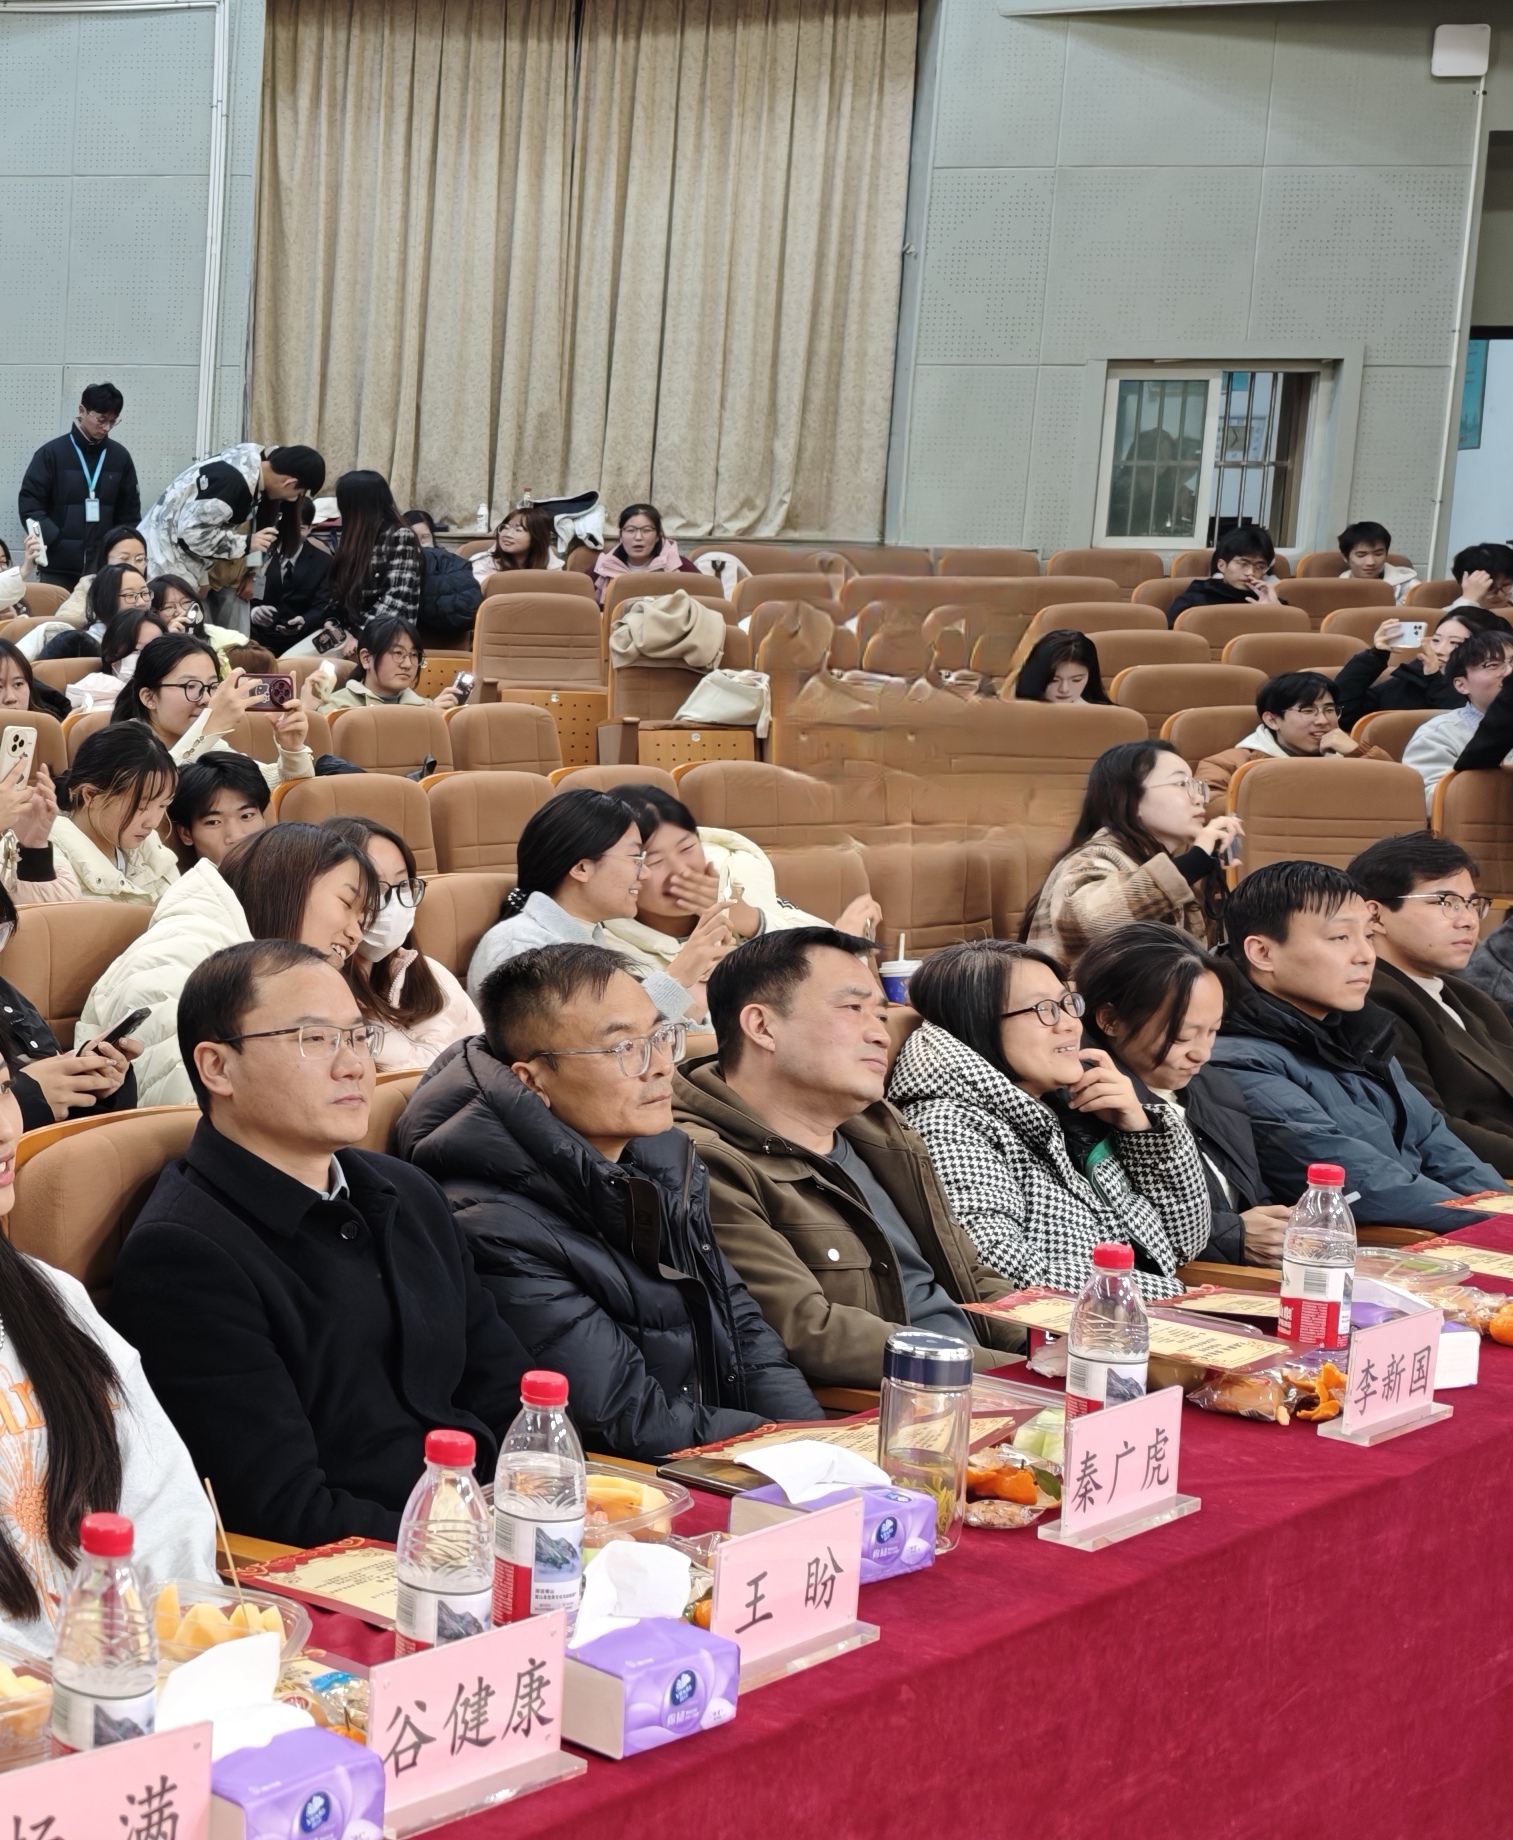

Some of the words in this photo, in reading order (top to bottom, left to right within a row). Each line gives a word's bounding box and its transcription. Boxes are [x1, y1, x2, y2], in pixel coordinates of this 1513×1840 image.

[1354, 1345, 1432, 1416] 李新国
[1071, 1428, 1170, 1514] 秦广虎
[383, 1657, 555, 1779] 谷健康
[12, 1774, 179, 1840] 满
